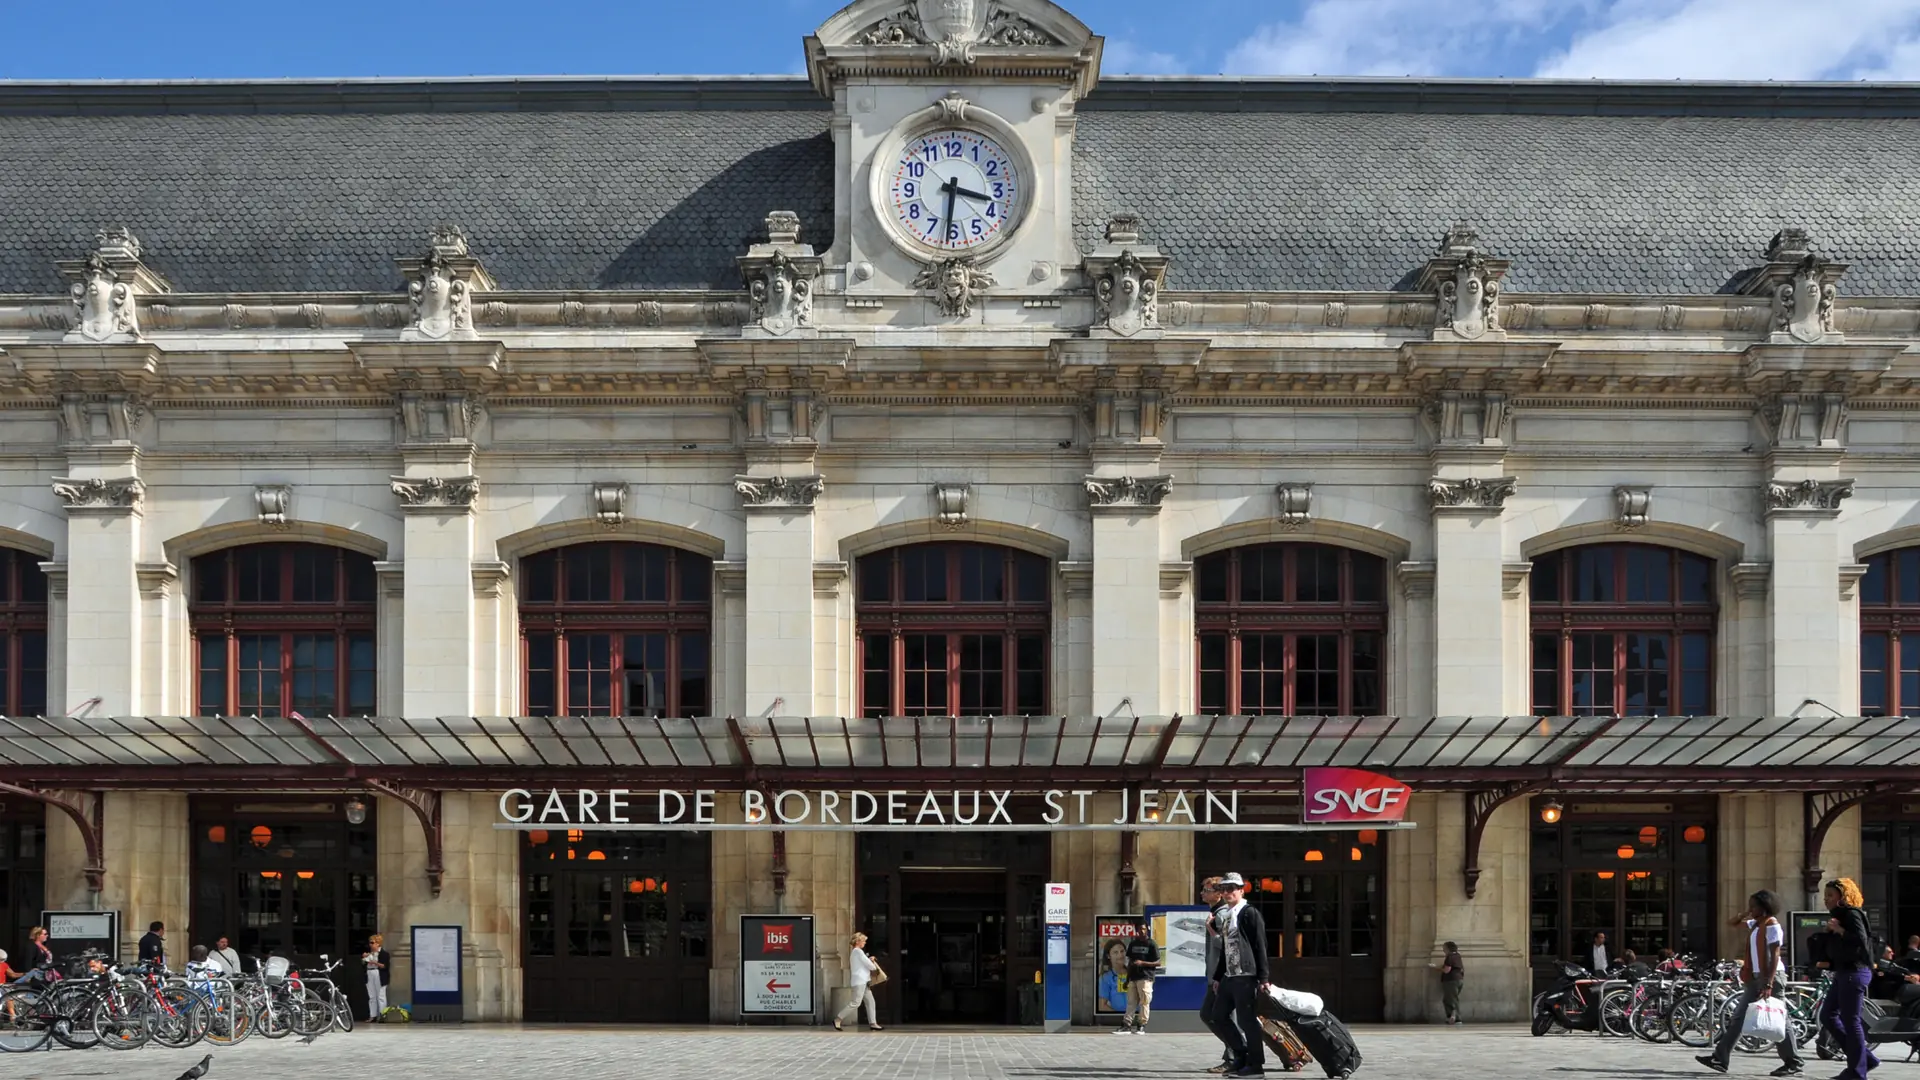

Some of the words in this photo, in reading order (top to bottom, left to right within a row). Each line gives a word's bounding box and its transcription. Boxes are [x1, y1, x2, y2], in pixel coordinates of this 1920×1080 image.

[923, 145, 937, 161] 11
[944, 142, 962, 157] 12
[971, 145, 978, 161] 1
[906, 162, 924, 177] 10
[986, 160, 997, 176] 2
[904, 182, 914, 197] 9
[993, 182, 1003, 198] 3
[909, 203, 920, 219] 8
[986, 202, 996, 218] 4
[927, 218, 938, 234] 7
[949, 223, 958, 239] 6
[971, 219, 982, 234] 5
[500, 787, 629, 823] GARE
[659, 789, 715, 823] DE
[745, 788, 1012, 824] BORDEAUX
[1042, 789, 1092, 824] ST
[1114, 788, 1237, 824] JEAN
[1310, 787, 1405, 814] SNCF
[767, 932, 788, 943] ibis
